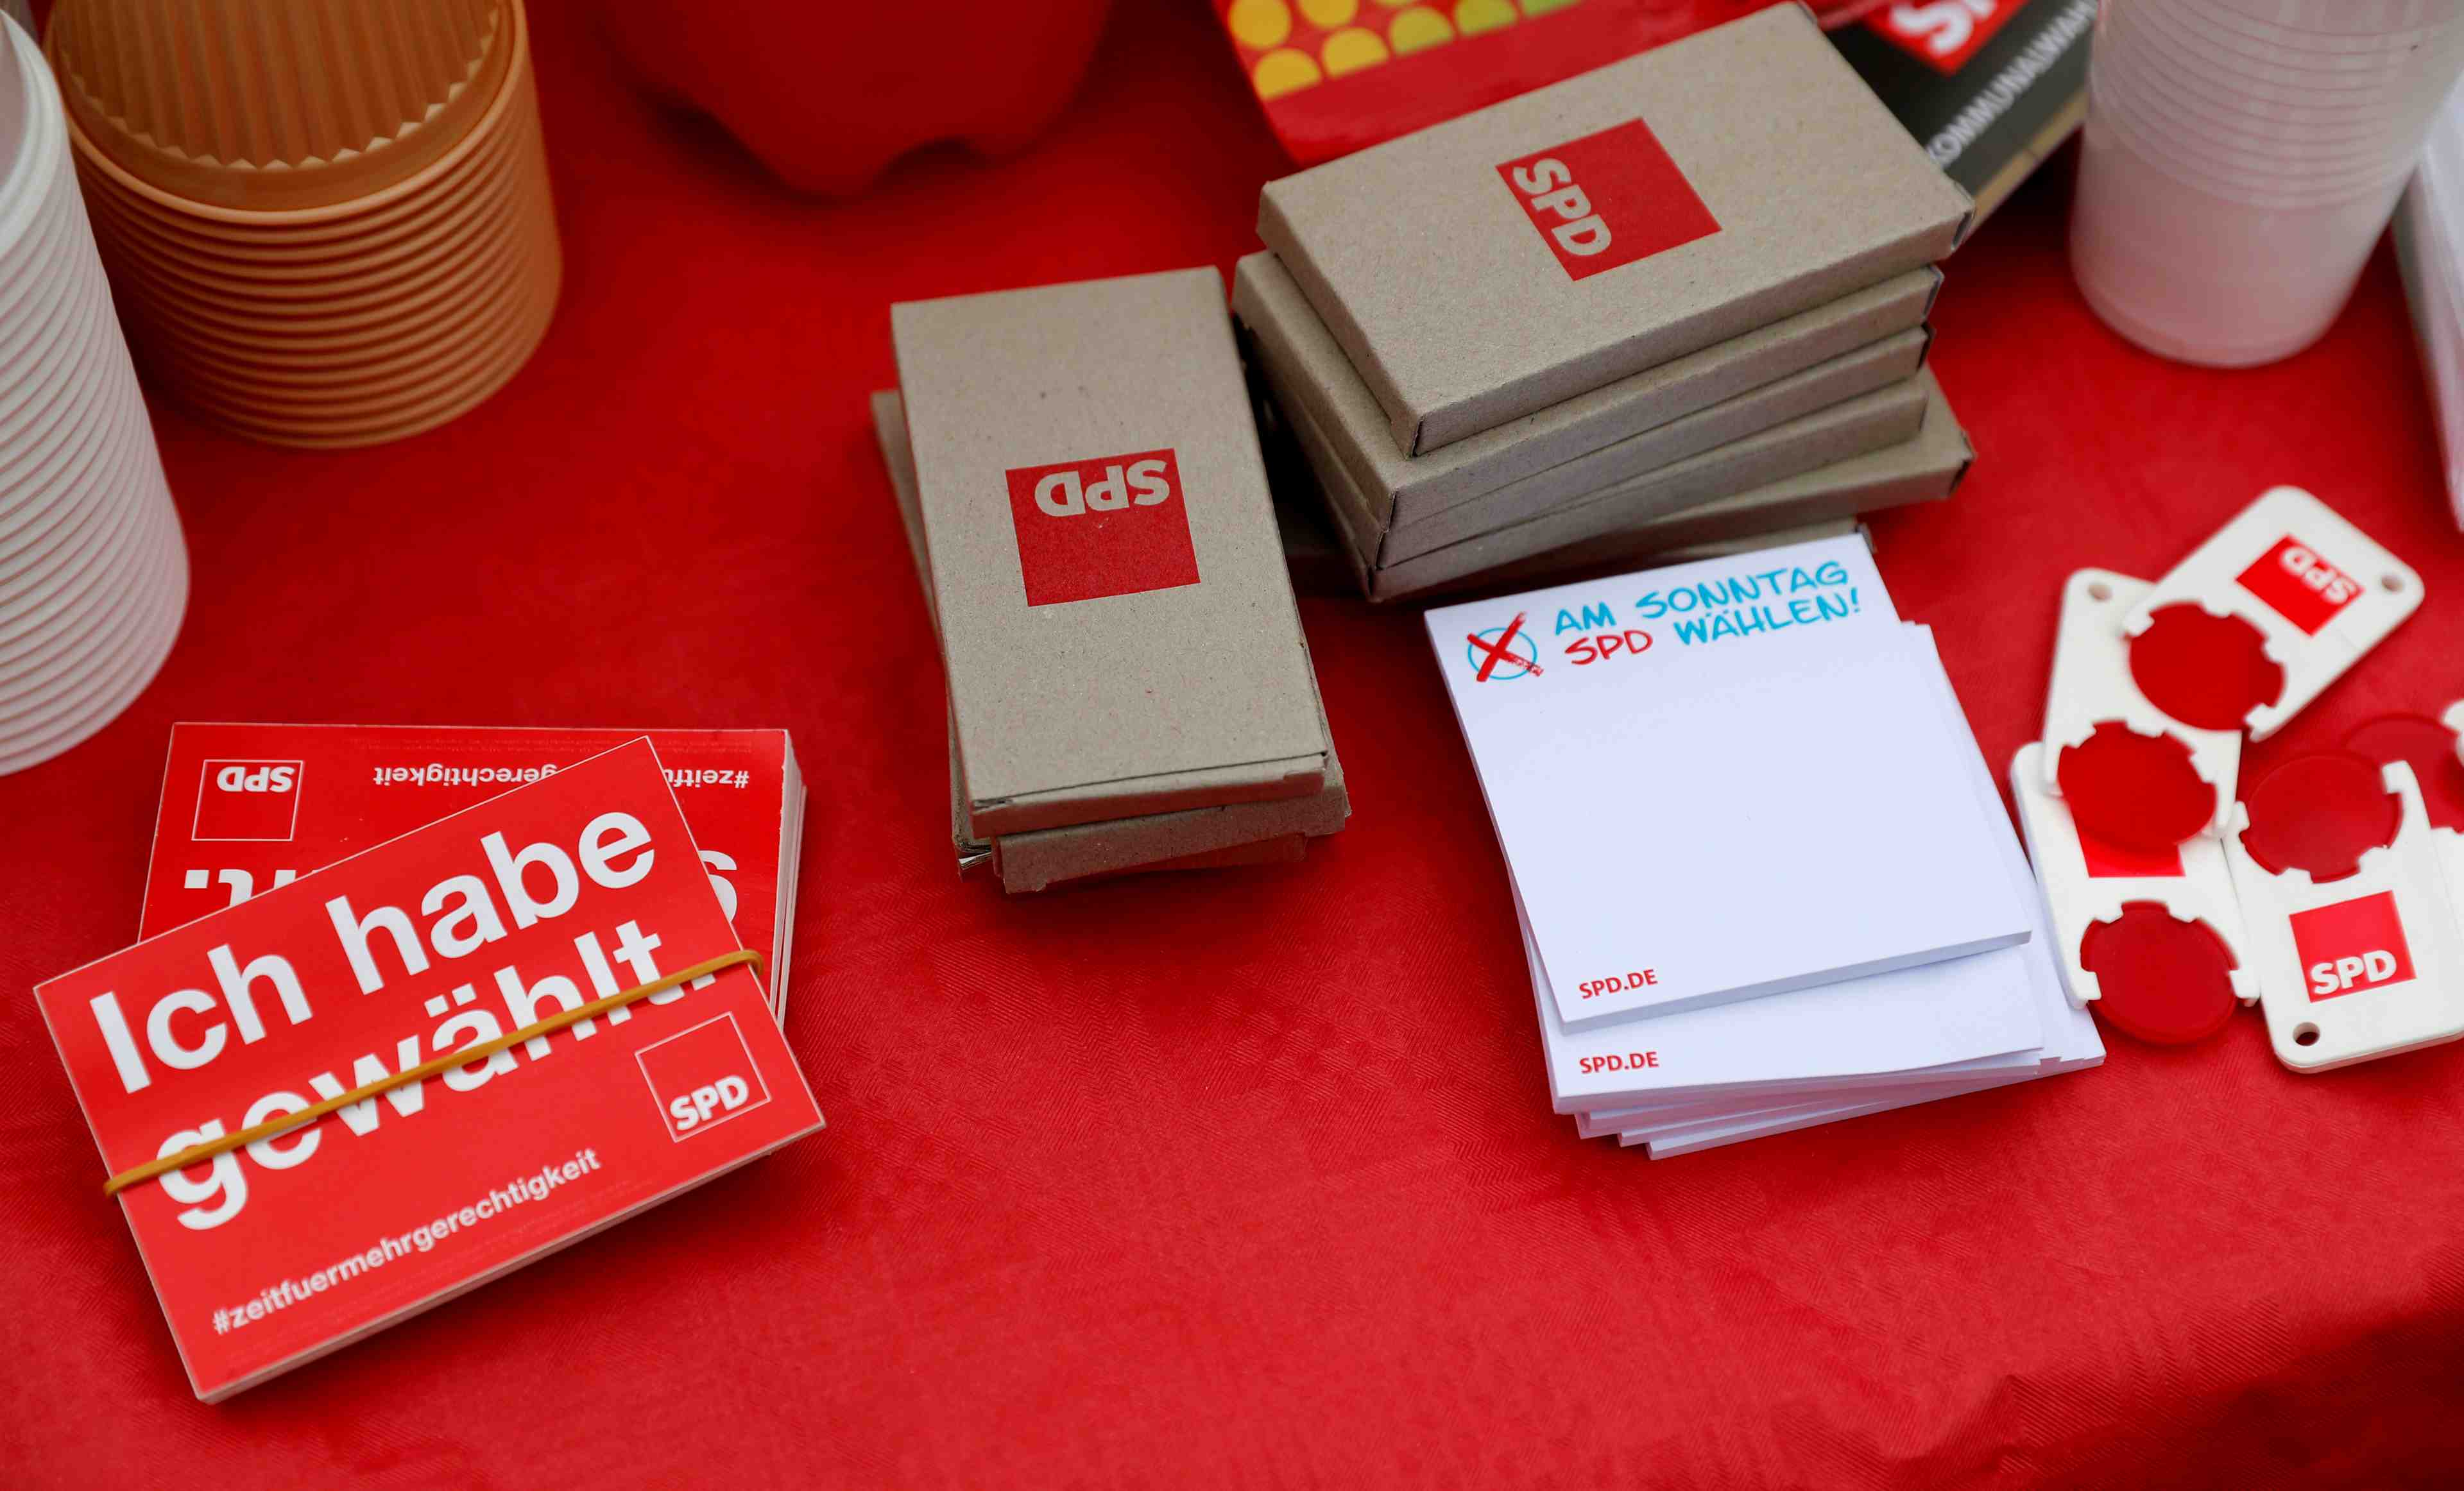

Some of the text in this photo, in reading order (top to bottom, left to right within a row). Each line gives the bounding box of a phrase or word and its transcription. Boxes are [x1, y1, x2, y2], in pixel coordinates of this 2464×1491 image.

[1512, 157, 1612, 256] SPD
[1034, 459, 1170, 517] SPD
[1554, 560, 1849, 635] AM SONNTAG
[2280, 545, 2357, 605] SPD
[1564, 588, 1860, 665] SPD WÄHLEN!
[216, 765, 295, 792] SPD
[89, 944, 313, 1094] Ich
[325, 812, 655, 996] habe
[2310, 950, 2396, 994] SPD
[1579, 968, 1658, 999] SPD.DE
[1579, 1051, 1659, 1075] SPD.DE
[669, 1075, 749, 1130] SPD
[212, 1148, 601, 1335] #zeitfuermehrgerechtigkeit
